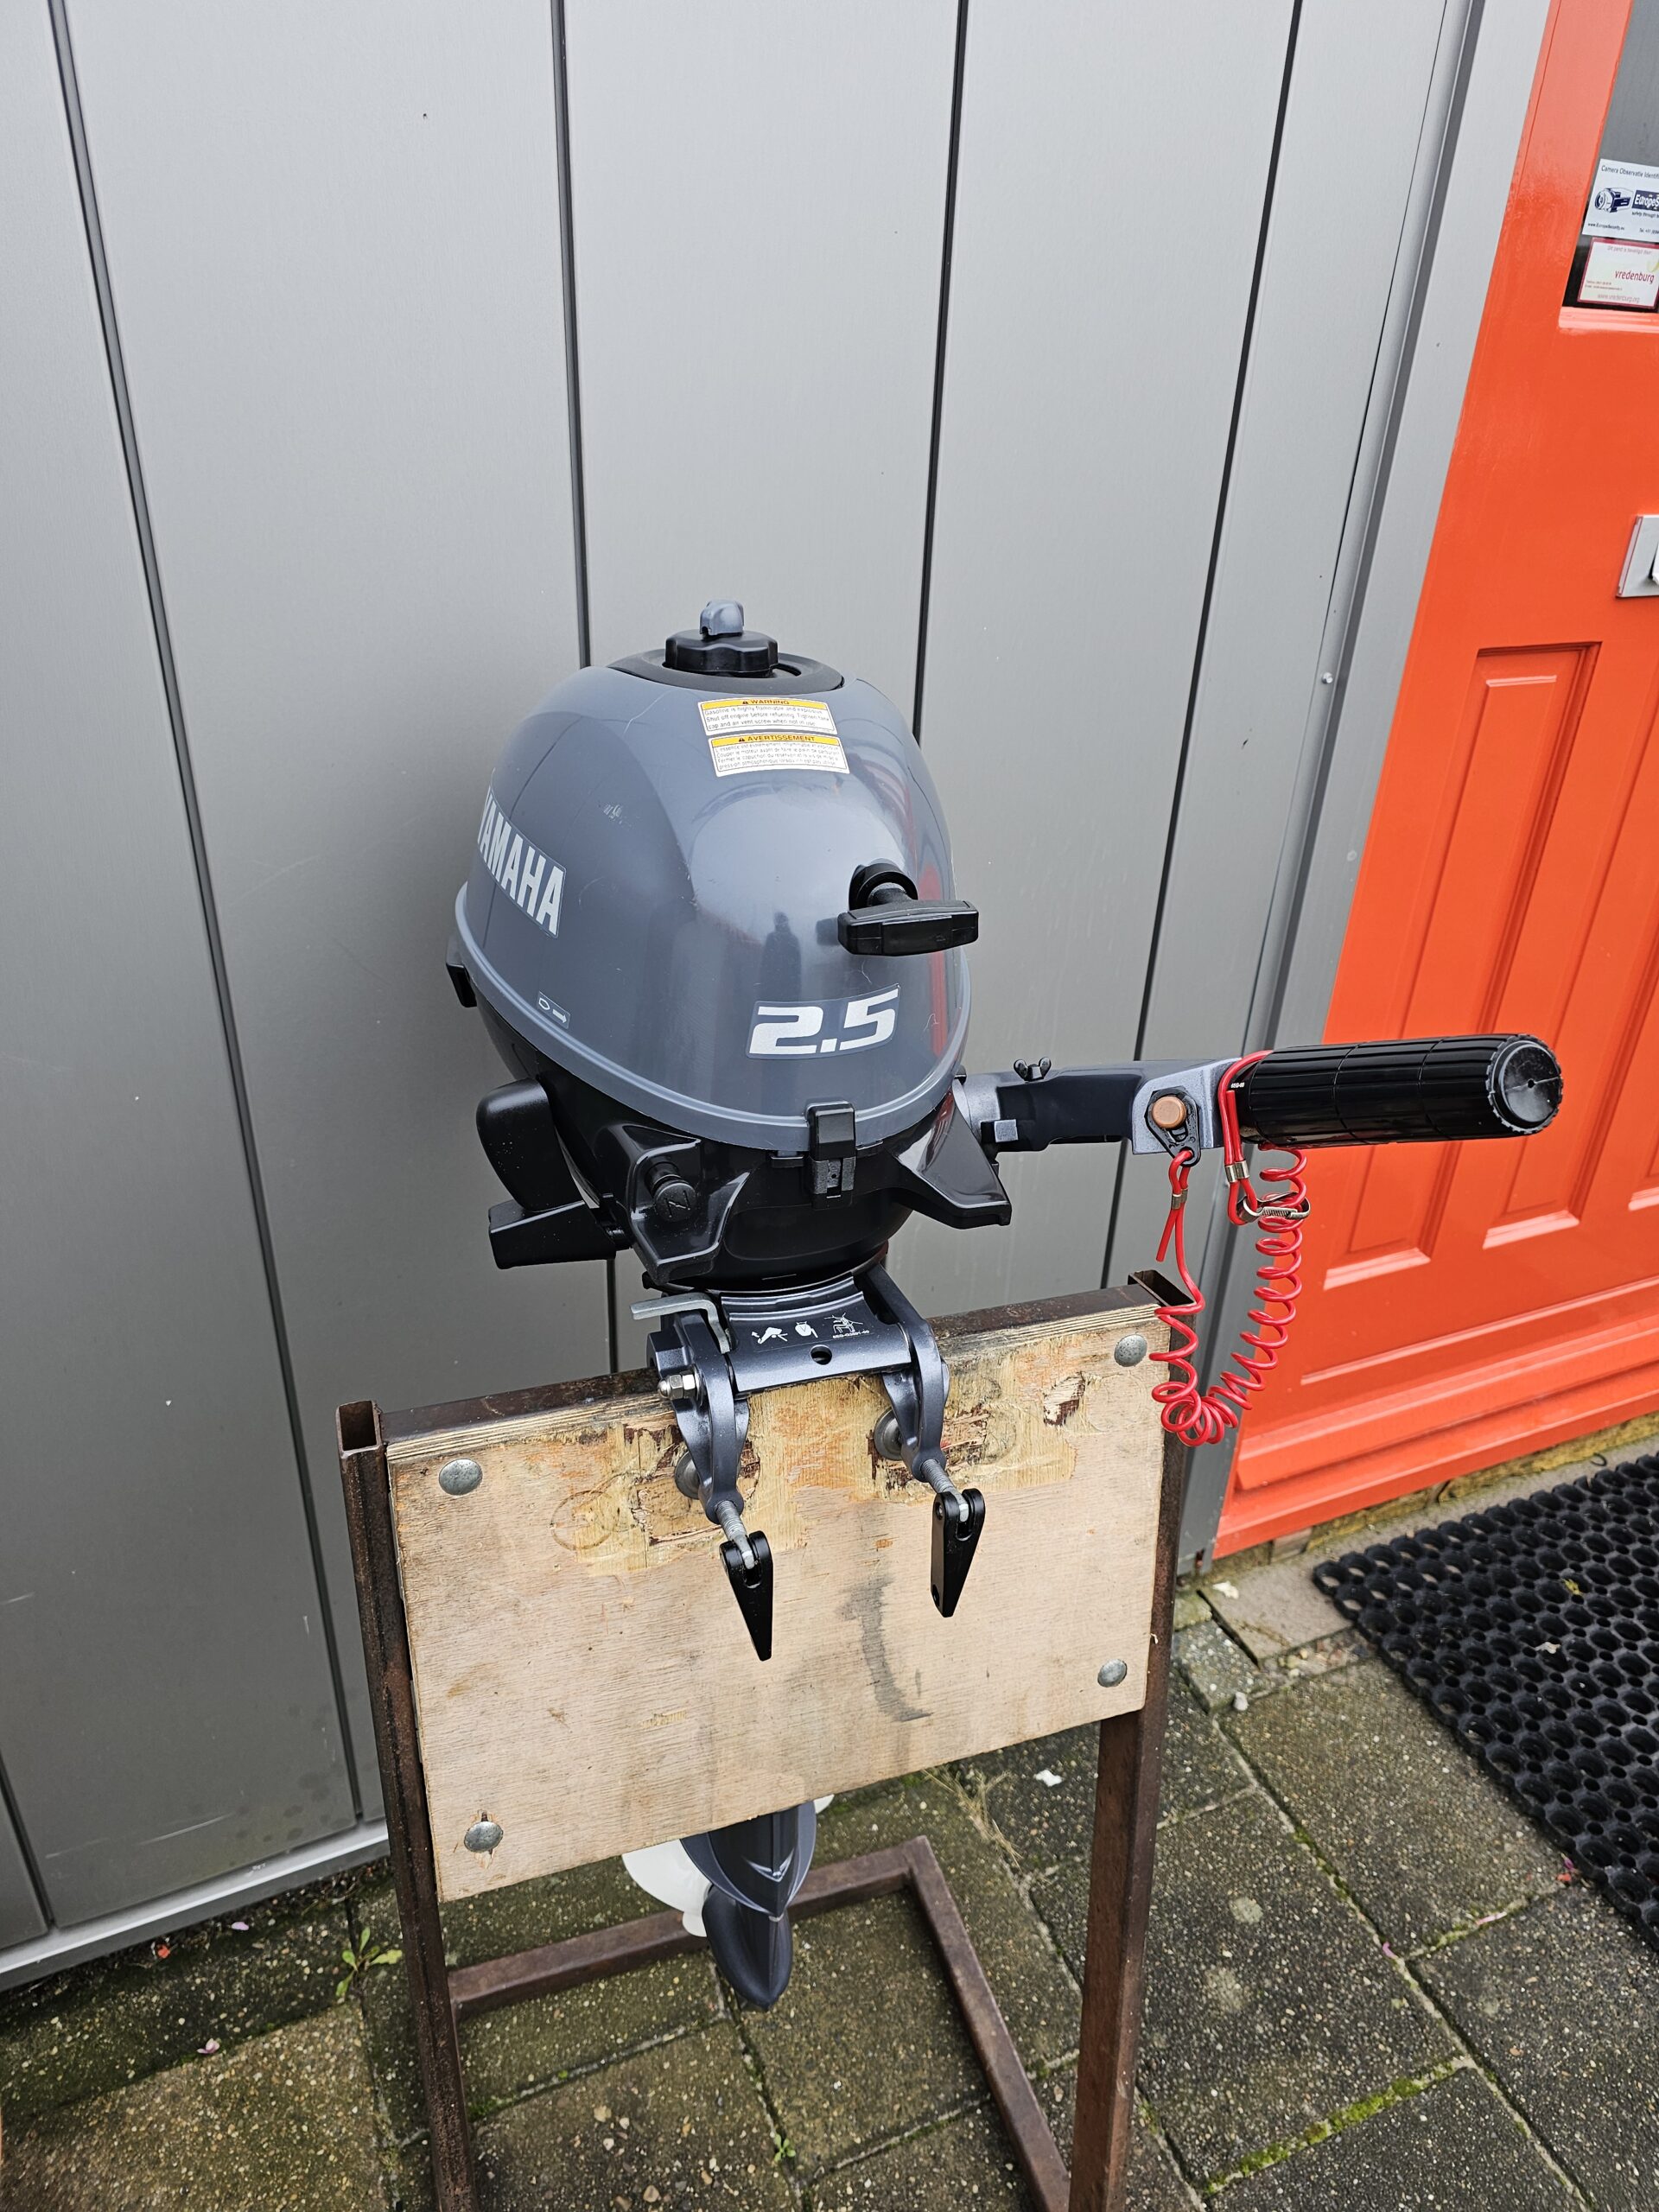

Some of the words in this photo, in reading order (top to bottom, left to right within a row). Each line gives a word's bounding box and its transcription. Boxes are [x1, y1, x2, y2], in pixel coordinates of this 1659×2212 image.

[1601, 165, 1618, 174] Camera
[1619, 168, 1643, 177] Observatie
[1615, 270, 1655, 283] vredenburg
[477, 785, 563, 936] YAMAHA
[749, 988, 899, 1054] 2.5
